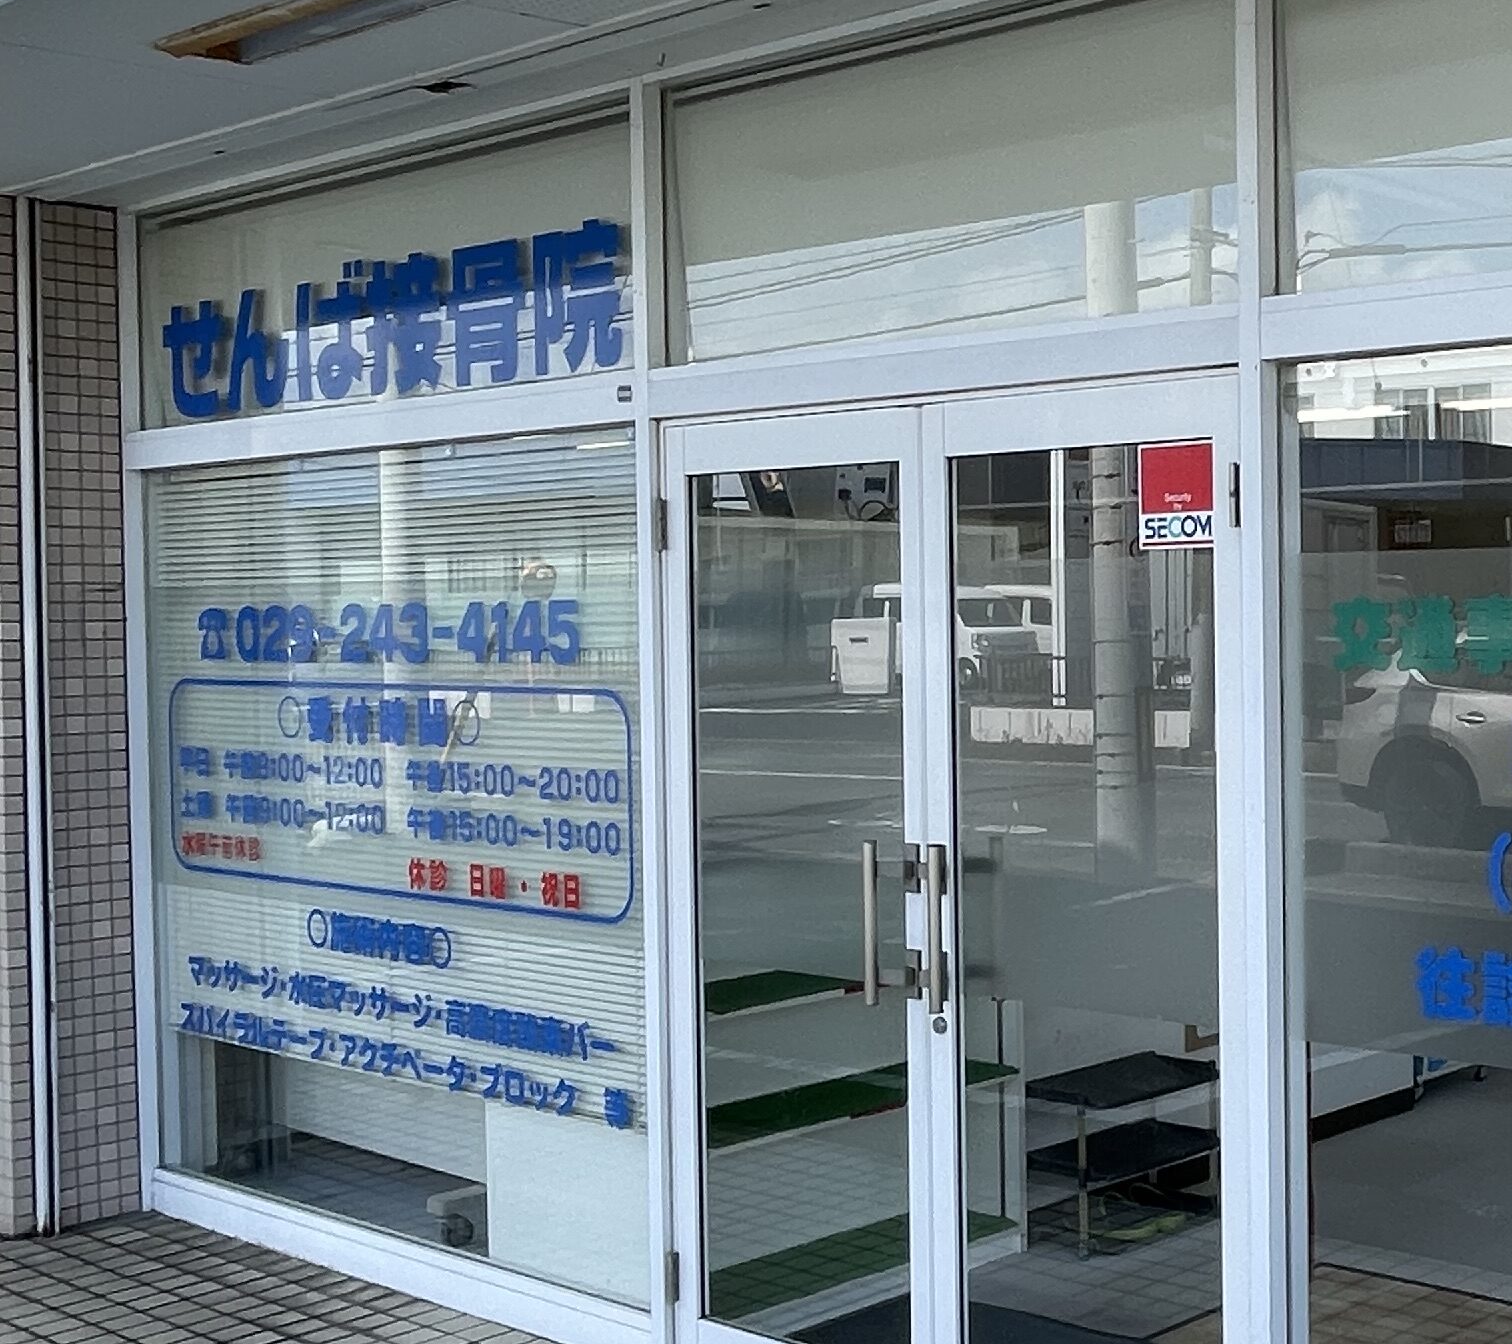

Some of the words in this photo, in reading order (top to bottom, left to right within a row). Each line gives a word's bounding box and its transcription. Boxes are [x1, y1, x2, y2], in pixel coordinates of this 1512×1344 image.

[162, 218, 624, 418] せんば接骨院
[1145, 514, 1212, 540] SECOM
[236, 600, 580, 666] 029-243-4145
[408, 856, 449, 892] 休診
